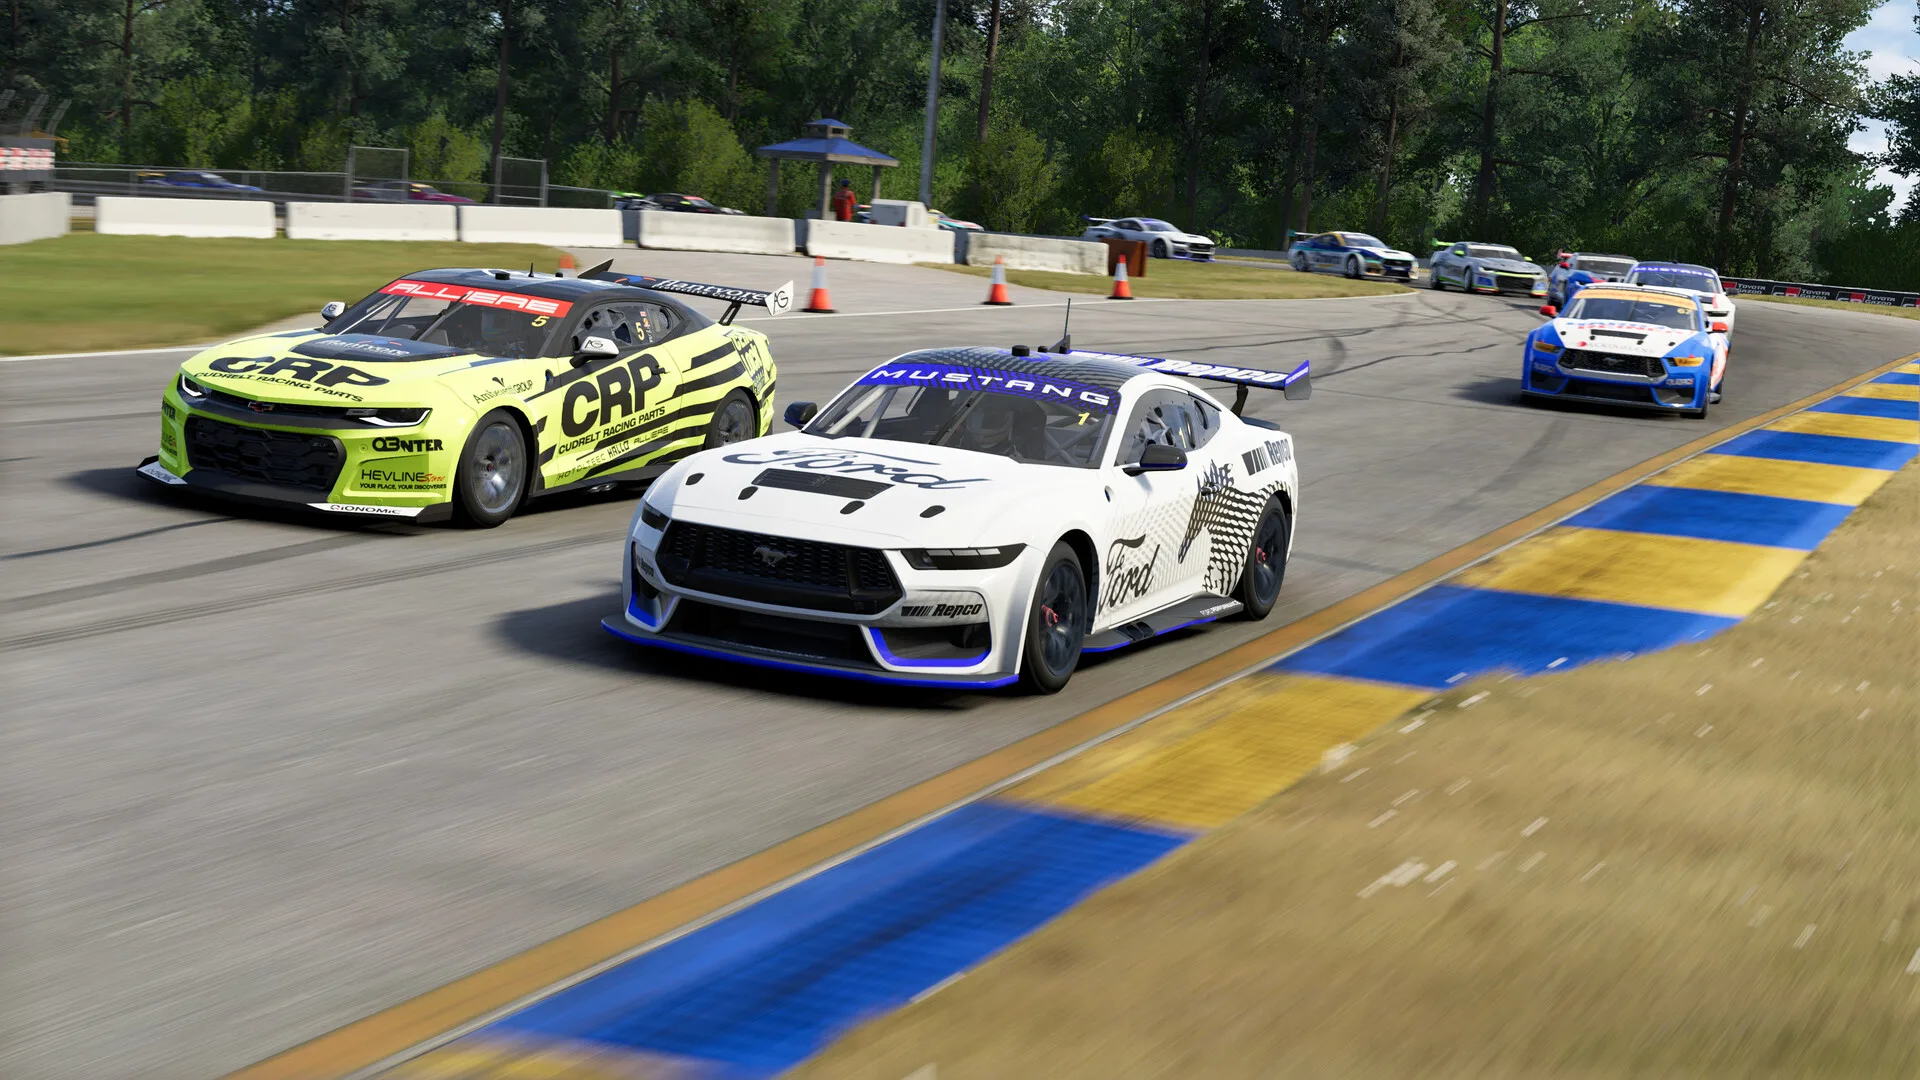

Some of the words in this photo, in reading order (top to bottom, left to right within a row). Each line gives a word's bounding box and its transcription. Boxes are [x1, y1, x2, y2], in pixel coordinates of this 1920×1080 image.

[1737, 283, 1766, 291] TOYOTA
[1801, 288, 1831, 297] TOYOTA
[1866, 294, 1896, 302] TOYOTA
[531, 315, 550, 328] 5
[635, 321, 645, 341] 5
[208, 355, 391, 388] CRP
[1146, 358, 1287, 384] Repco
[193, 372, 255, 380] CUDRELT
[256, 375, 312, 389] RACING
[314, 386, 364, 402] PARTS
[561, 353, 662, 438] CRP
[871, 369, 1110, 406] MUSTANG
[1078, 411, 1091, 426] 1
[558, 430, 601, 455] CUDRELT
[603, 417, 637, 439] RACING
[638, 406, 666, 425] PARTS
[1178, 427, 1187, 449] 1
[1264, 438, 1293, 469] Repco
[361, 469, 425, 483] HEVLINE
[722, 446, 993, 490] Ford
[359, 482, 377, 490] YOUR
[377, 482, 397, 490] PLACE,
[1098, 533, 1161, 617] Ford
[931, 603, 983, 619] Repco
